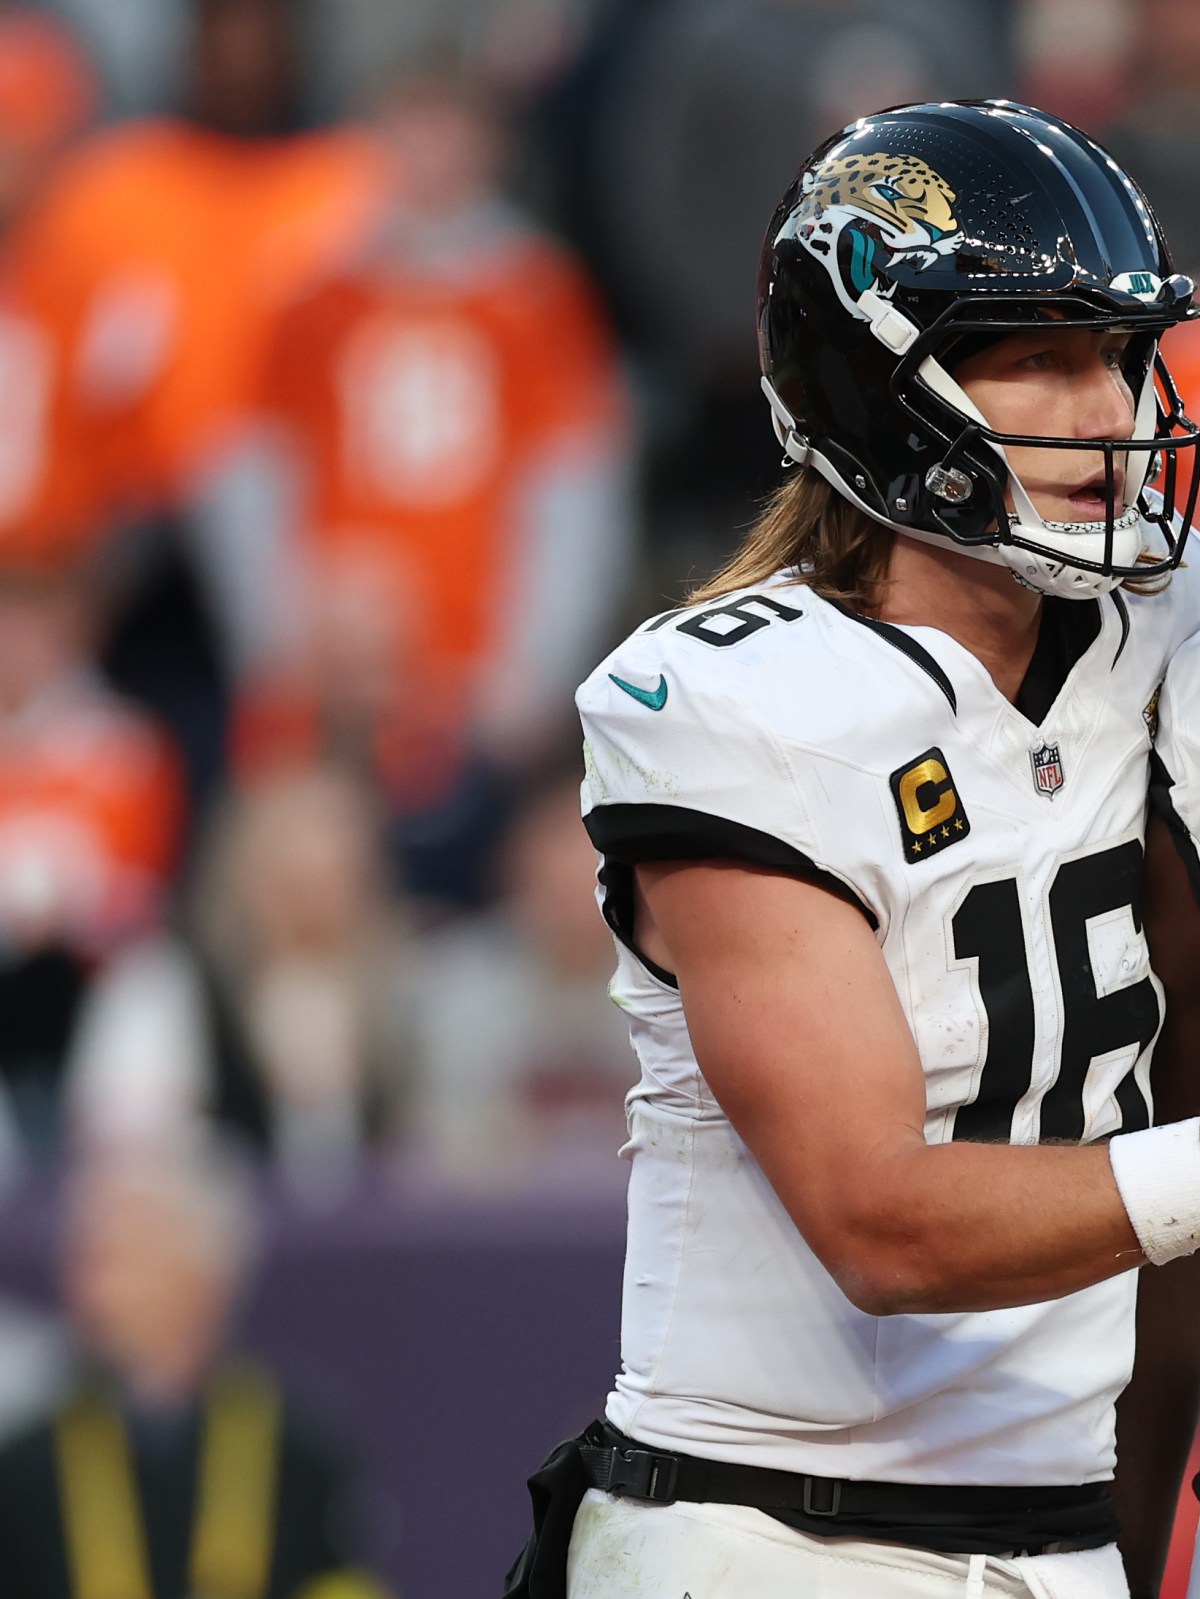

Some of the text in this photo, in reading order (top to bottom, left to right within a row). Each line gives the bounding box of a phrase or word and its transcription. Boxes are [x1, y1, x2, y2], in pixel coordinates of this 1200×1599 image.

[1127, 274, 1155, 294] JAX
[899, 758, 956, 834] C
[1038, 765, 1061, 788] NFL
[951, 838, 1160, 1145] 16
